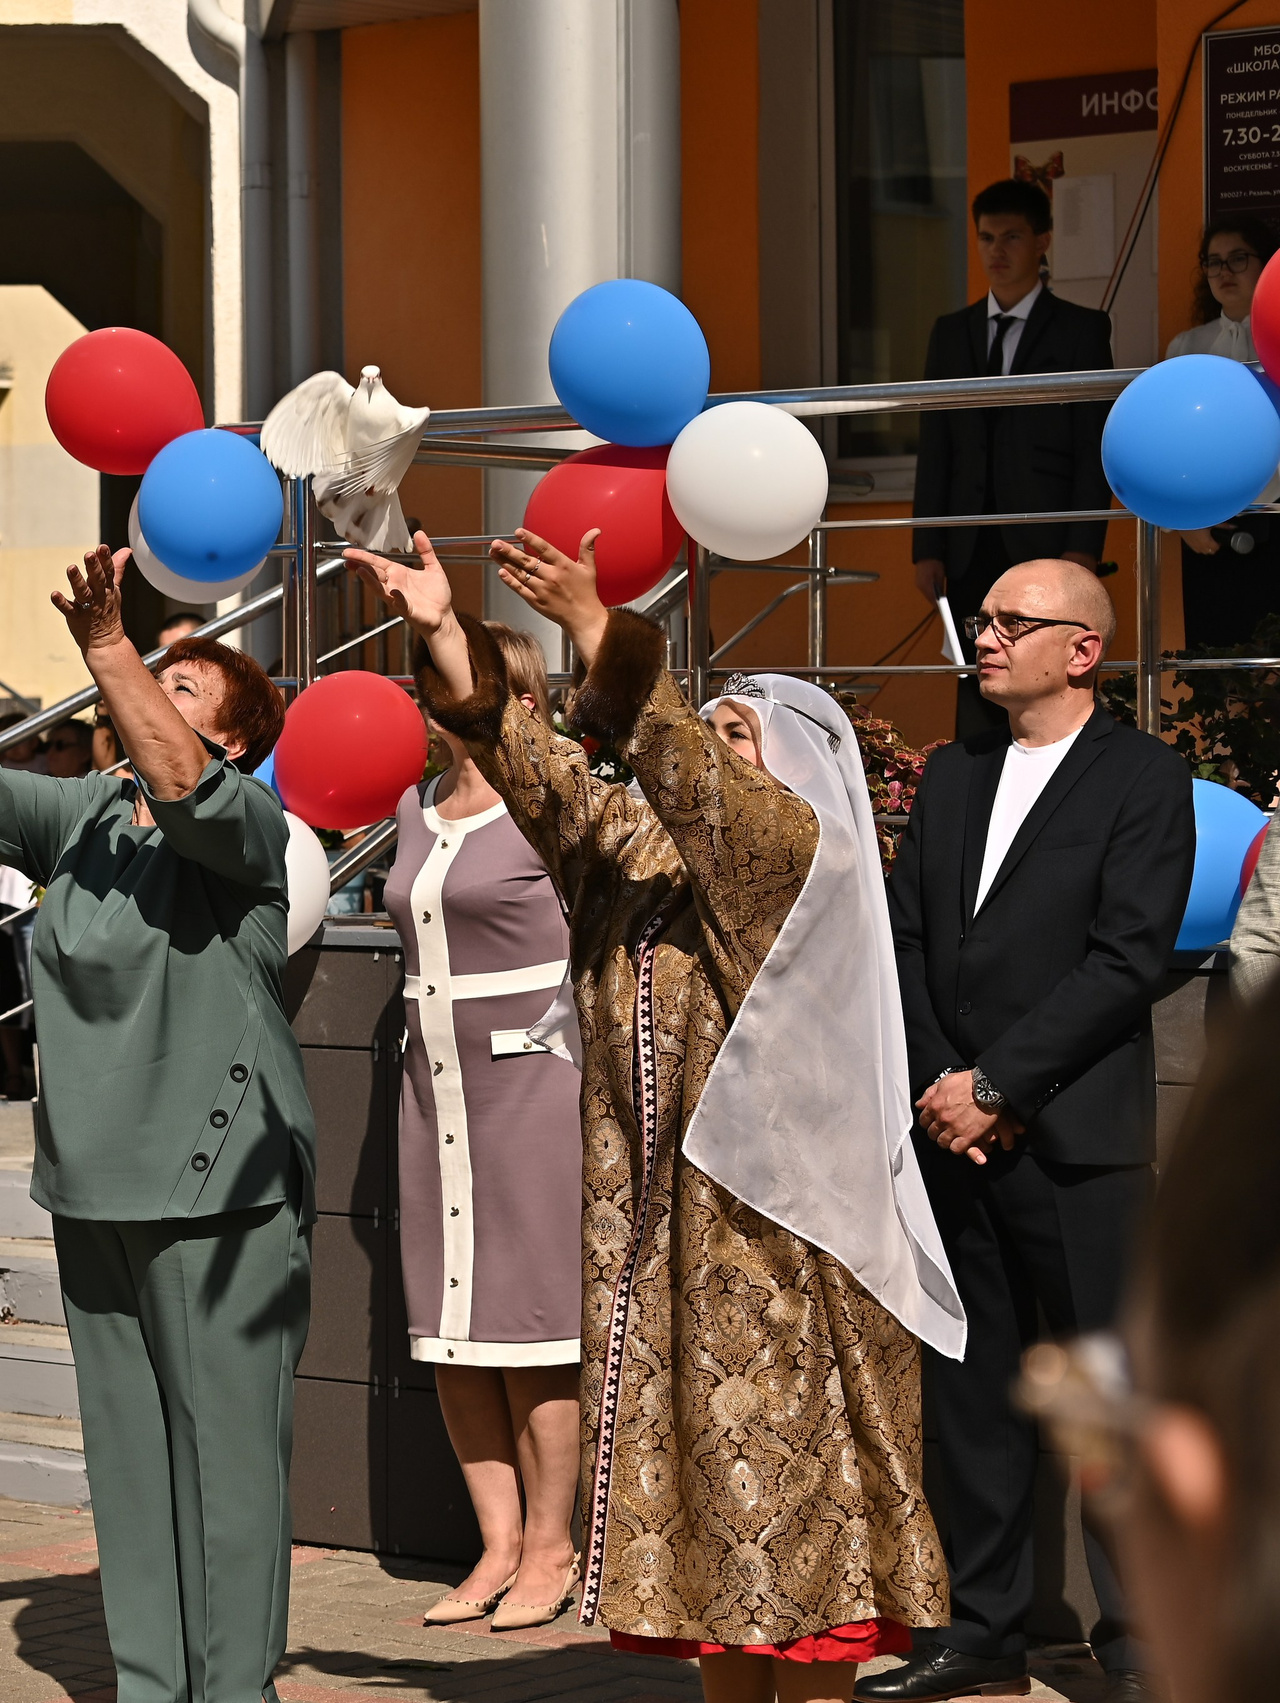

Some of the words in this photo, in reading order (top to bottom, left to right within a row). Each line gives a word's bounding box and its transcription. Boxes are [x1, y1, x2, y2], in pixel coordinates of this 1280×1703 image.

[1220, 90, 1266, 105] РЕЖИМ
[1226, 108, 1278, 119] ПОНЕДЕЛЬНИК
[1238, 152, 1270, 160] СУББОТА
[1223, 162, 1272, 173] ВОСКРЕСЕНЬЕ
